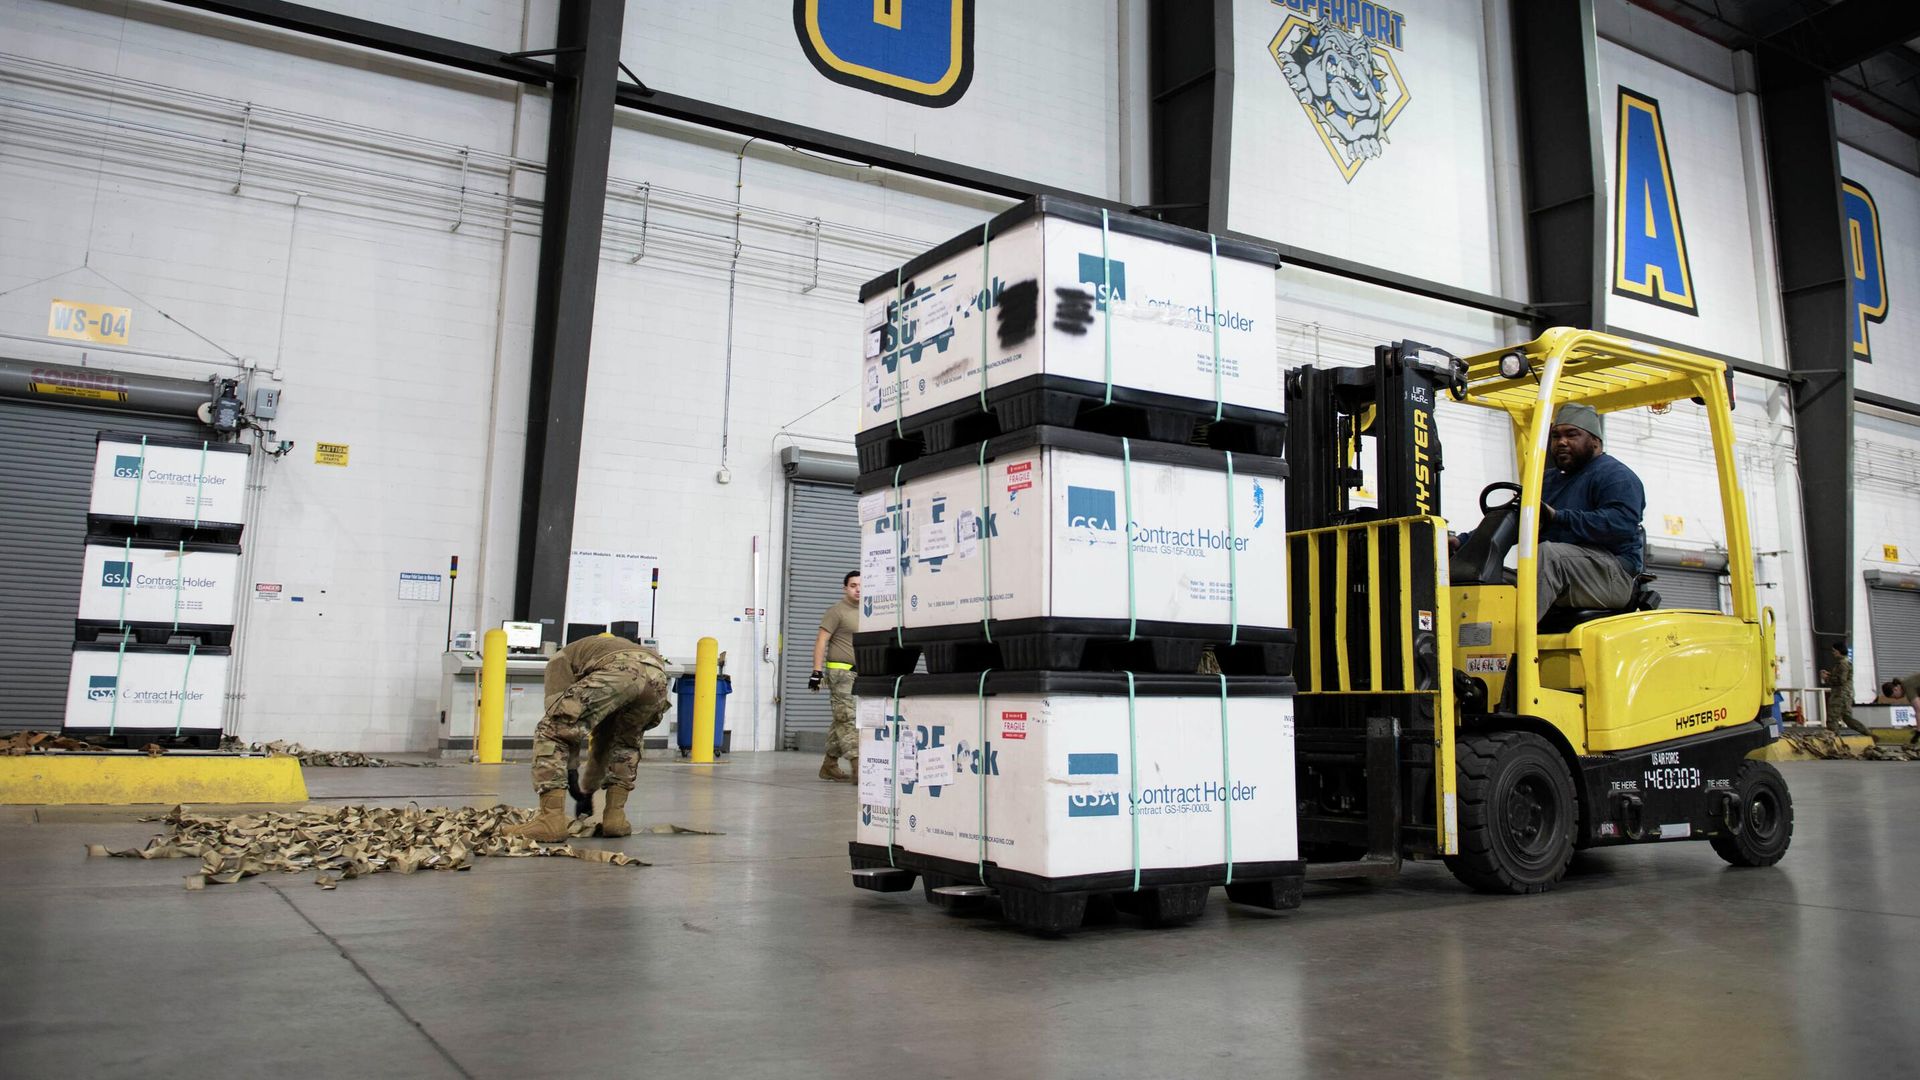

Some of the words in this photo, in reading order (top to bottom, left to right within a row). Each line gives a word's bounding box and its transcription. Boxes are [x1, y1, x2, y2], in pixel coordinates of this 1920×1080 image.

[1612, 84, 1699, 317] A
[53, 306, 127, 337] WS-04
[1205, 306, 1254, 333] Holder
[1412, 385, 1426, 395] LIFT
[1414, 408, 1431, 523] HYSTER
[148, 470, 191, 482] Contract
[193, 473, 227, 485] Holder
[1009, 472, 1030, 483] FRAGILE
[1071, 515, 1111, 530] GSA
[1126, 521, 1195, 548] Contract
[1132, 545, 1158, 554] ontract
[104, 573, 130, 584] GSA
[183, 577, 217, 588] Holder
[1675, 711, 1713, 730] HYSTER
[1714, 707, 1727, 721] 50
[1004, 722, 1025, 731] FRAGILE
[867, 757, 890, 765] RETROGRADE
[1652, 752, 1658, 765] US
[1658, 752, 1666, 765] AIR
[1666, 751, 1679, 764] FORCE
[1611, 781, 1621, 790] TIE
[1621, 780, 1637, 789] HERE
[1706, 779, 1715, 788] TIE
[1716, 778, 1730, 787] HERE
[1128, 784, 1201, 804] Contract
[1204, 780, 1257, 801] Holder
